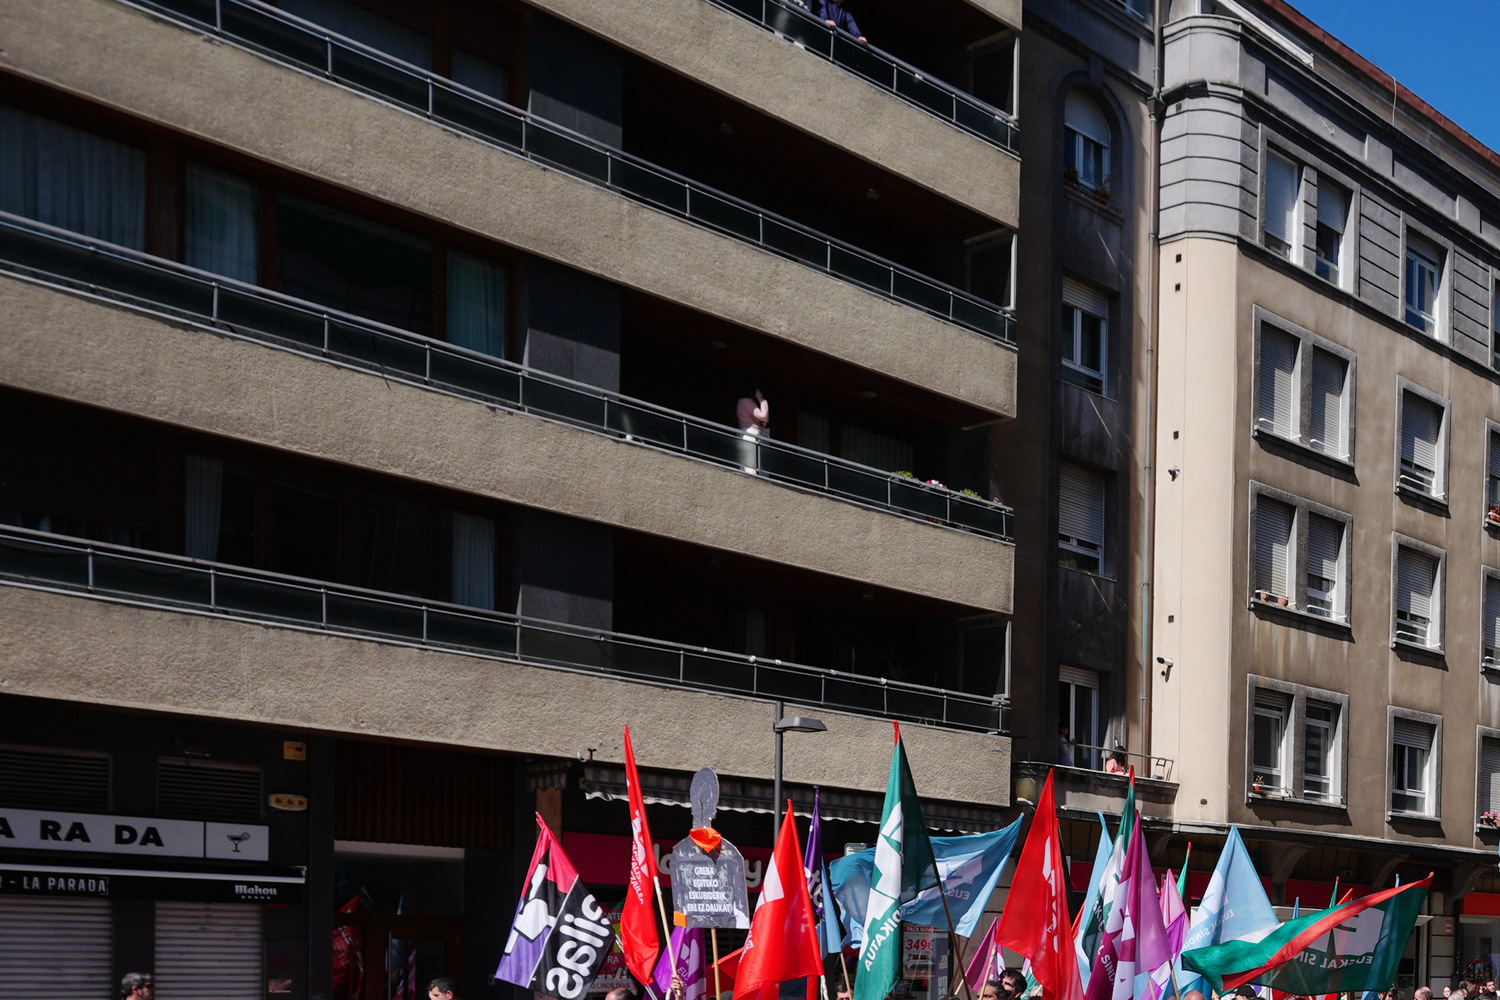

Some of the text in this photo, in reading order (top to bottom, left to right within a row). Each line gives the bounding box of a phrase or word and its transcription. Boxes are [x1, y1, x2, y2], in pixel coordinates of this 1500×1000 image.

[40, 819, 91, 843] RA
[114, 824, 164, 847] DA
[694, 866, 715, 875] GREBA
[22, 876, 106, 892] LA PARADA
[693, 879, 718, 887] EGITEKO
[235, 884, 277, 896] Mahou
[689, 891, 726, 900] ESKUBIDERIK
[687, 903, 698, 911] ERE
